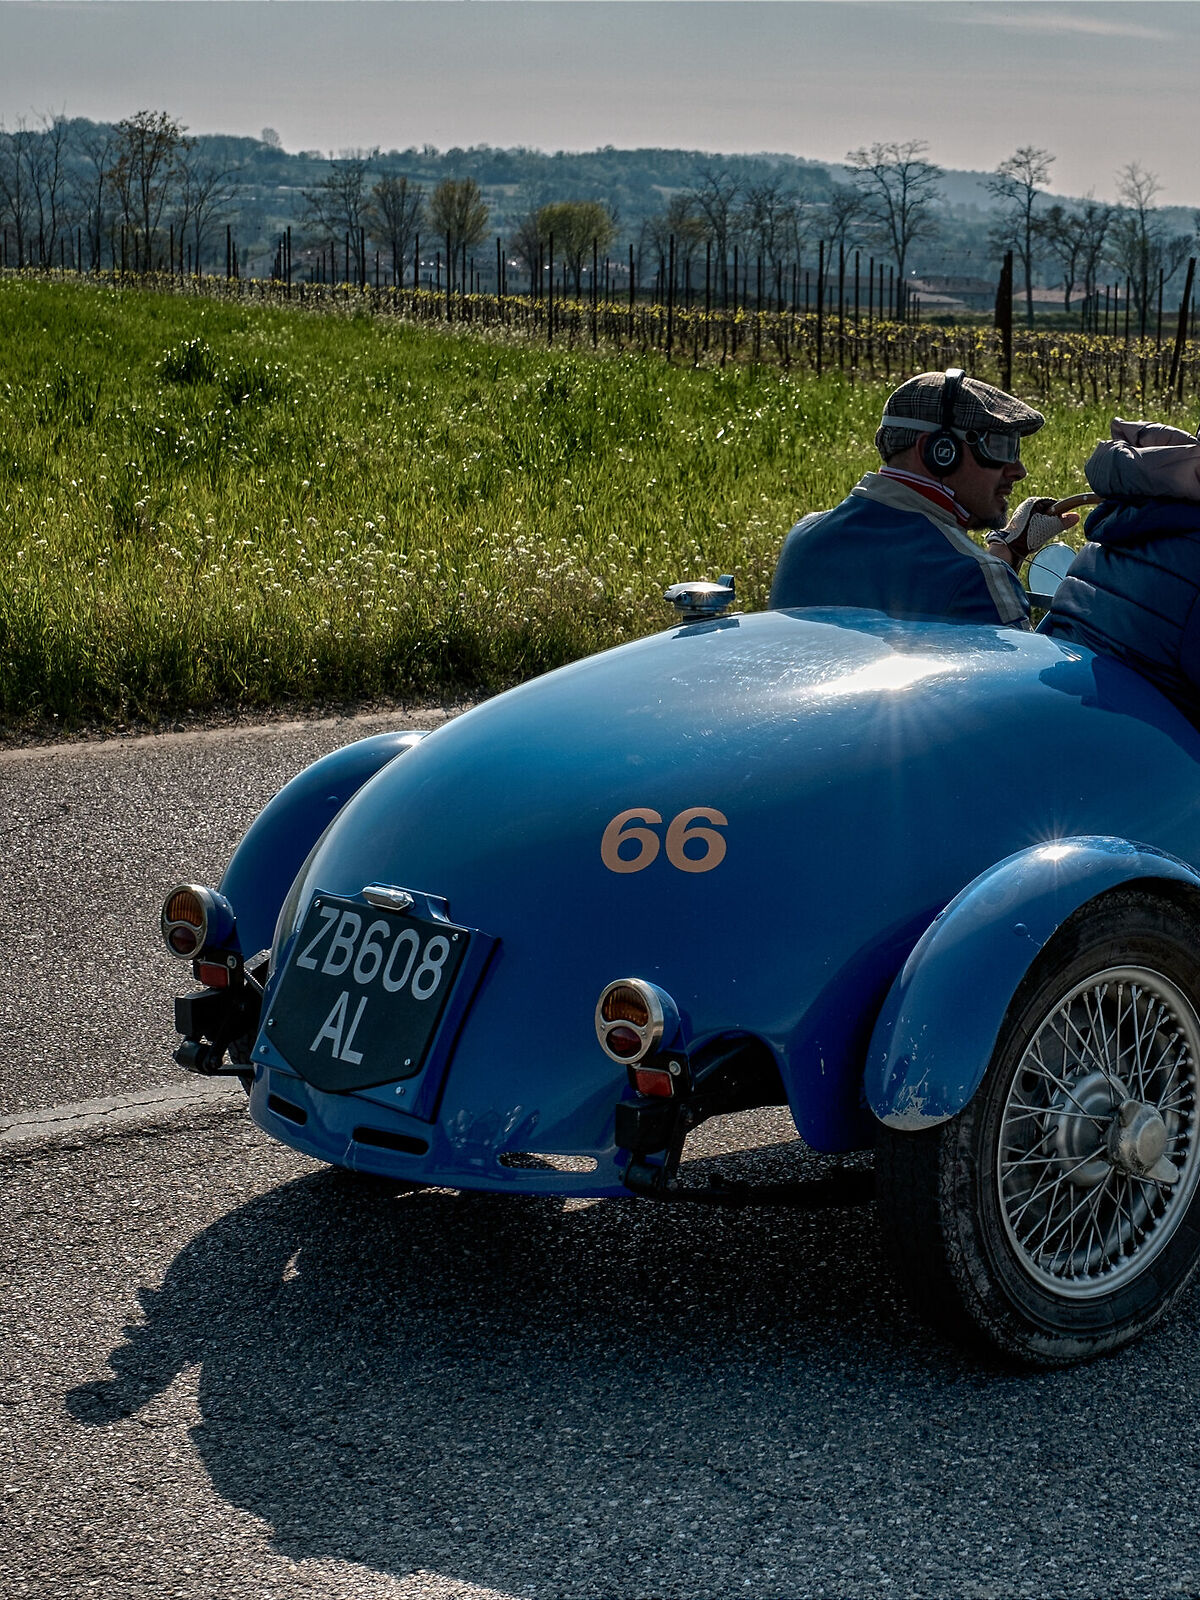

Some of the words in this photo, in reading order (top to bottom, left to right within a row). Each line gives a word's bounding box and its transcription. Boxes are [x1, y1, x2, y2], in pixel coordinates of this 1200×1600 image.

[601, 806, 728, 874] 66
[296, 905, 450, 1001] ZB608
[309, 990, 368, 1065] AL
